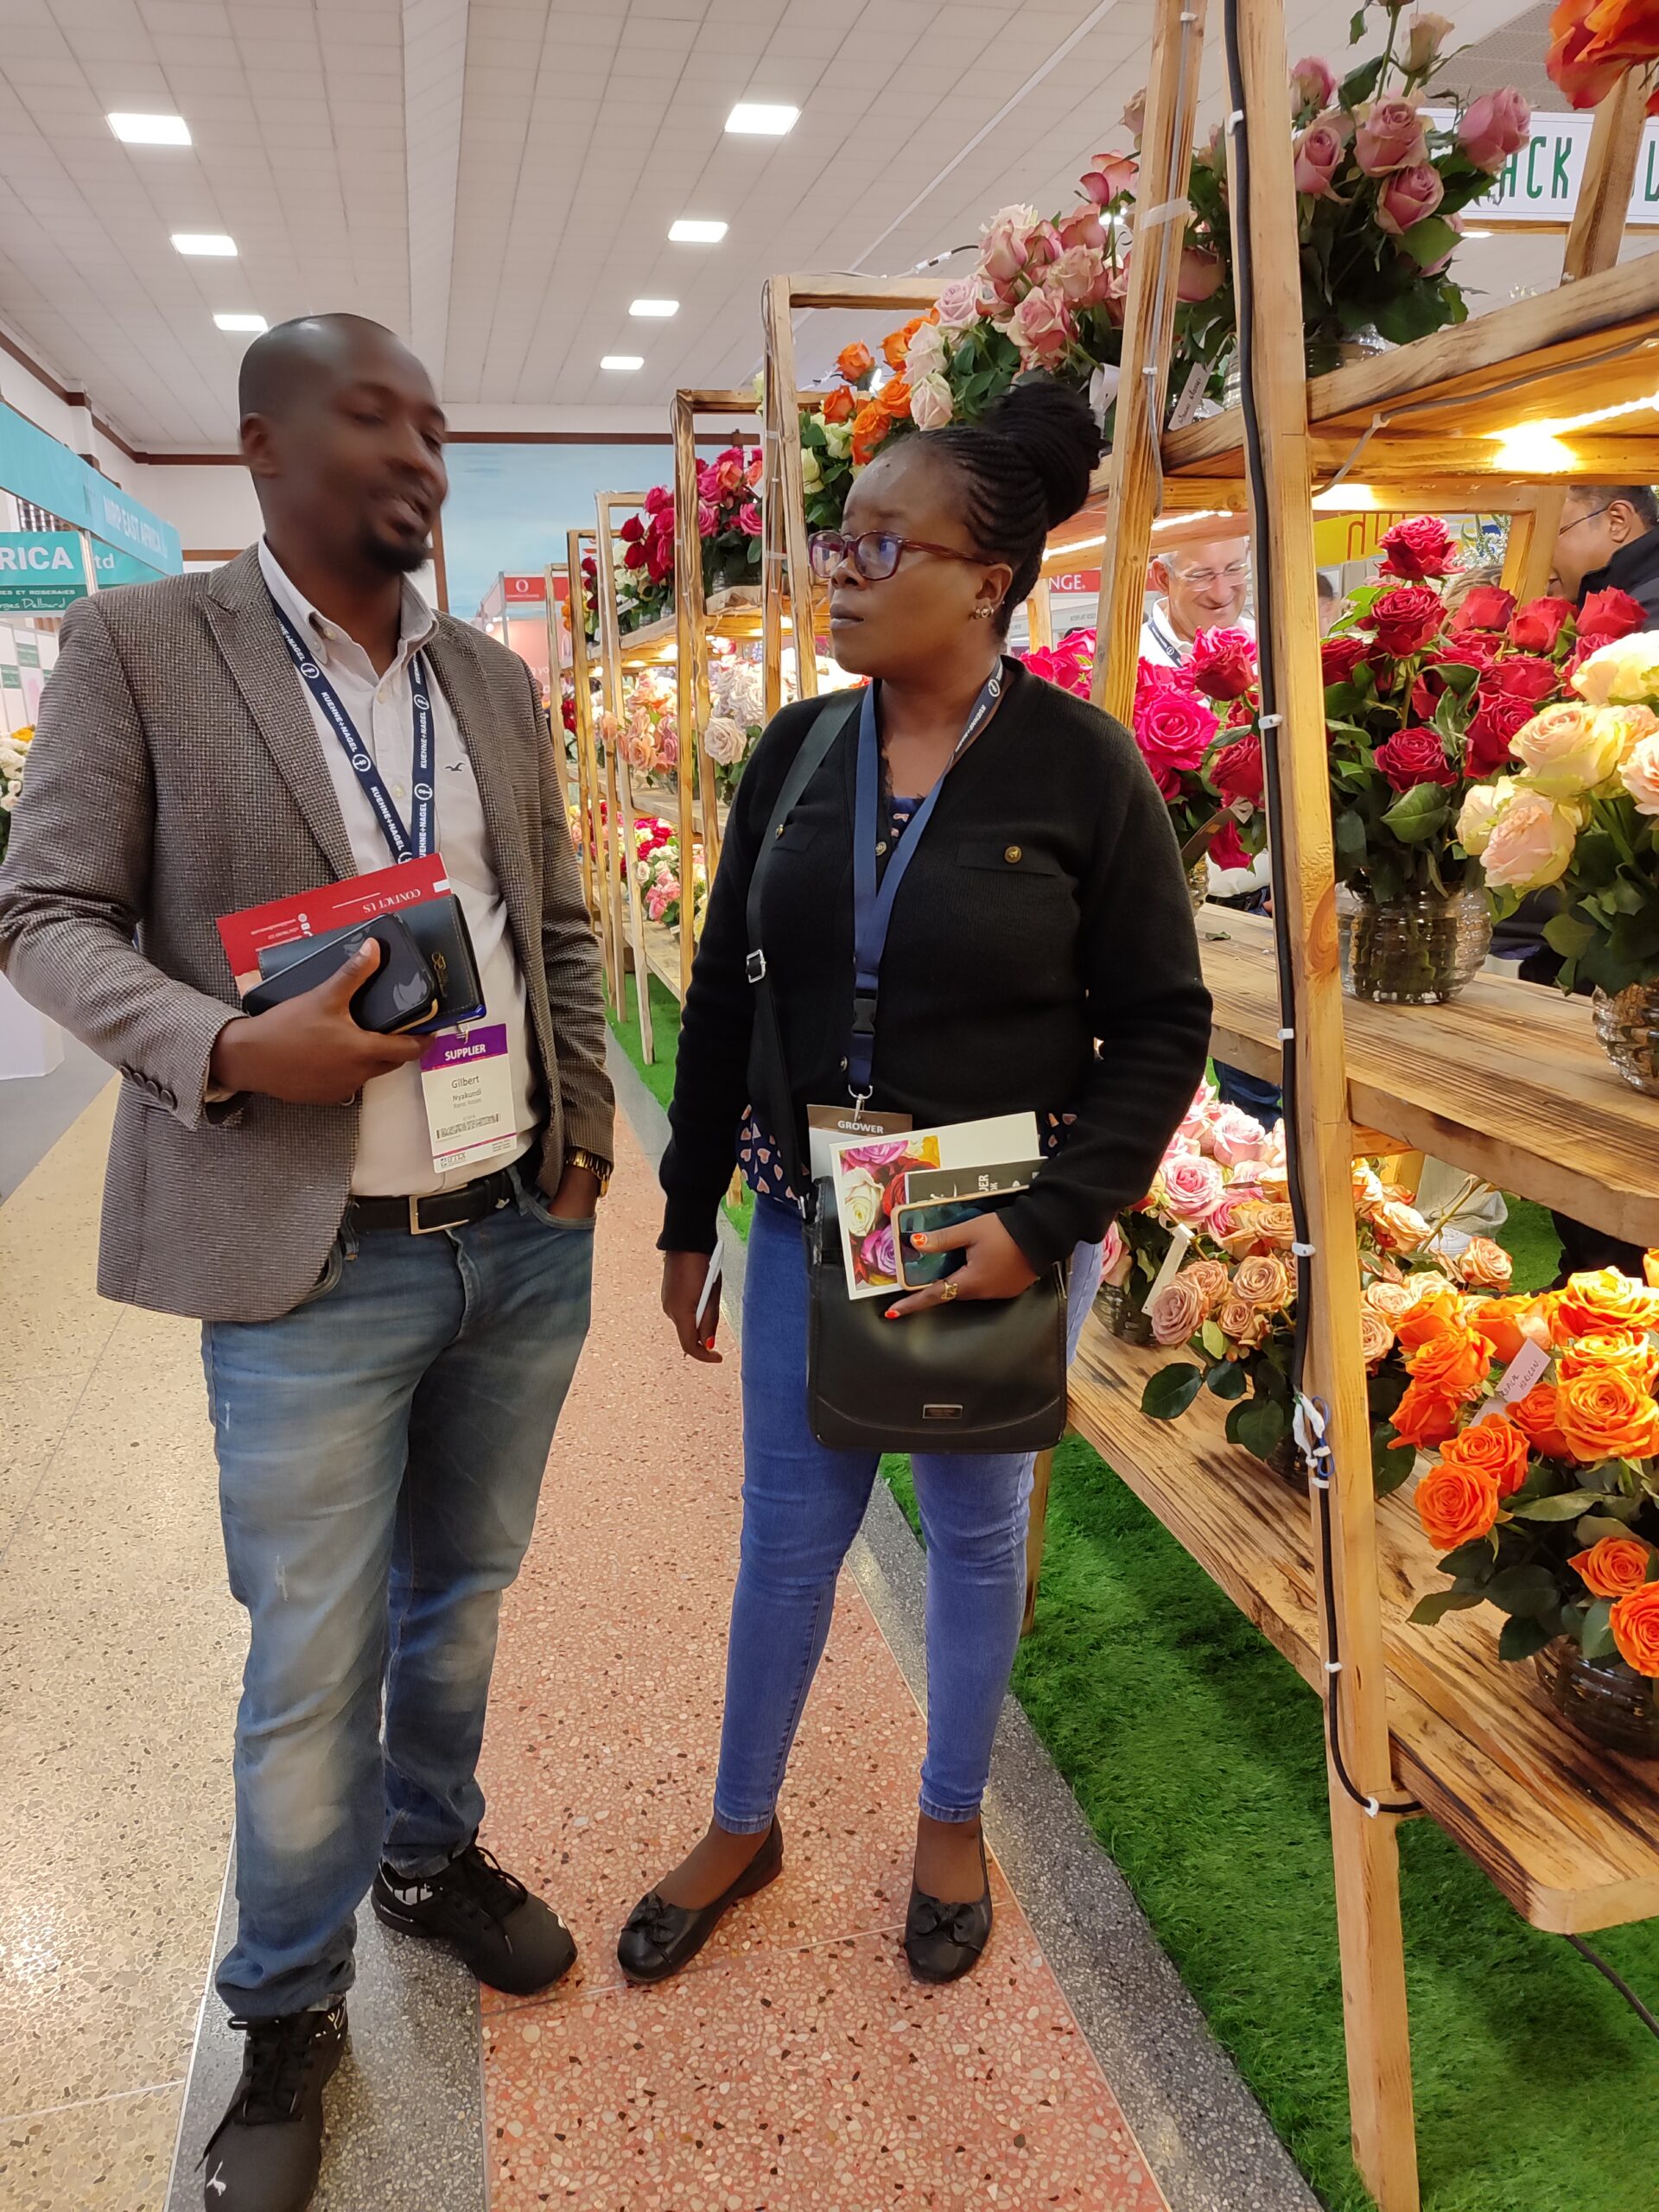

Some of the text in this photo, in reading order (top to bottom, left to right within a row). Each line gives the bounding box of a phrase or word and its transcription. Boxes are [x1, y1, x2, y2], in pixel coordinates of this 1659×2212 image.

[94, 553, 116, 569] td
[321, 691, 359, 753] KUEHNE+NAGEL
[370, 785, 405, 851] KUEHNE+NAGEL
[418, 802, 428, 859] UEHNE+NAGEL
[362, 888, 422, 913] CONTACT US
[444, 1043, 487, 1062] SUPPLIER
[451, 1076, 480, 1089] Gilbert
[837, 1120, 884, 1134] GROWER
